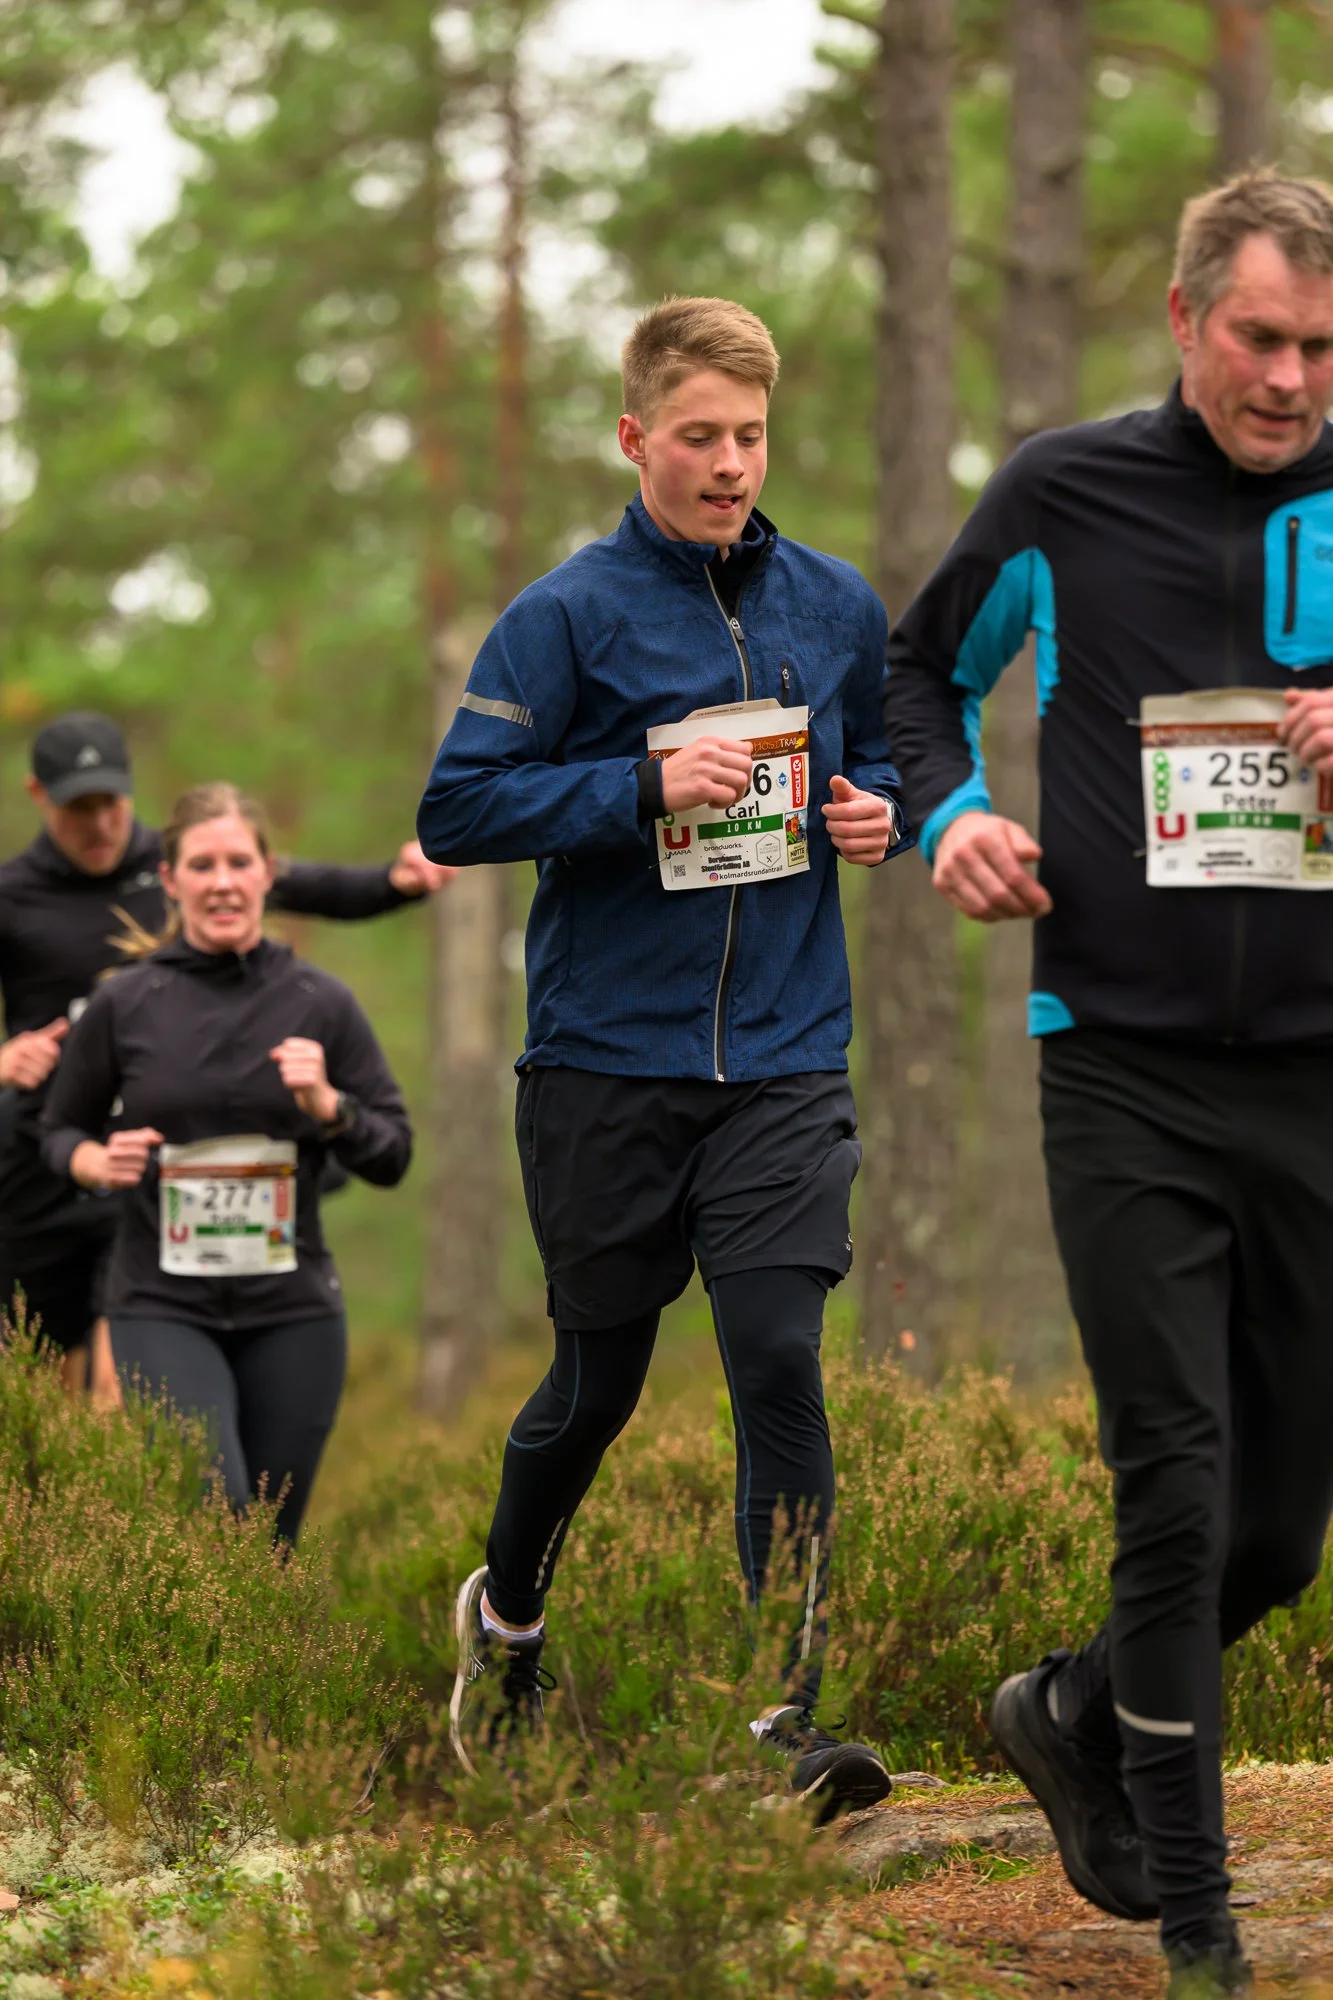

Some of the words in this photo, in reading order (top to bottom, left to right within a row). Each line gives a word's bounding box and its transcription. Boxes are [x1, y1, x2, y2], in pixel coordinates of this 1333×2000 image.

[1208, 752, 1289, 788] 255
[794, 773, 802, 804] CIRCLE
[725, 801, 760, 819] Carl
[1222, 793, 1277, 811] Peter
[727, 822, 739, 833] 10
[747, 820, 762, 831] KM
[203, 1183, 255, 1210] 277
